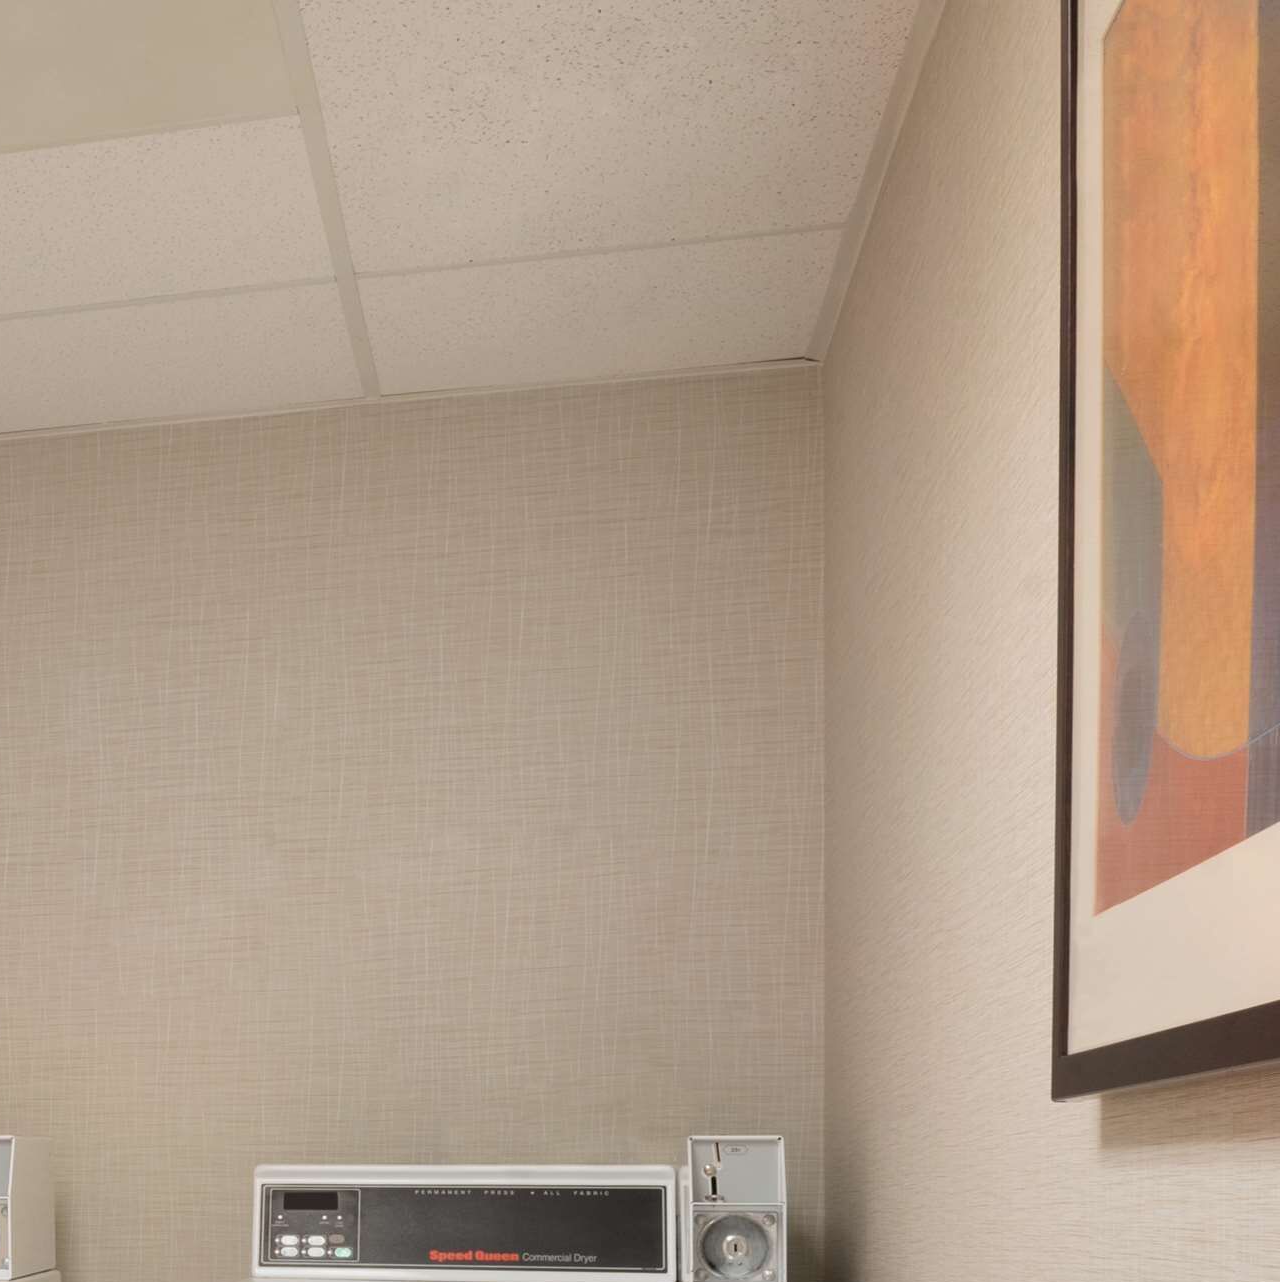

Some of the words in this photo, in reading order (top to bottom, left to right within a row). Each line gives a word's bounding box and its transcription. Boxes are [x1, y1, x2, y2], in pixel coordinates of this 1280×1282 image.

[429, 1250, 473, 1262] Speed
[475, 1250, 519, 1261] Queen
[522, 1252, 572, 1262] Commercial
[573, 1253, 597, 1264] Dryer
